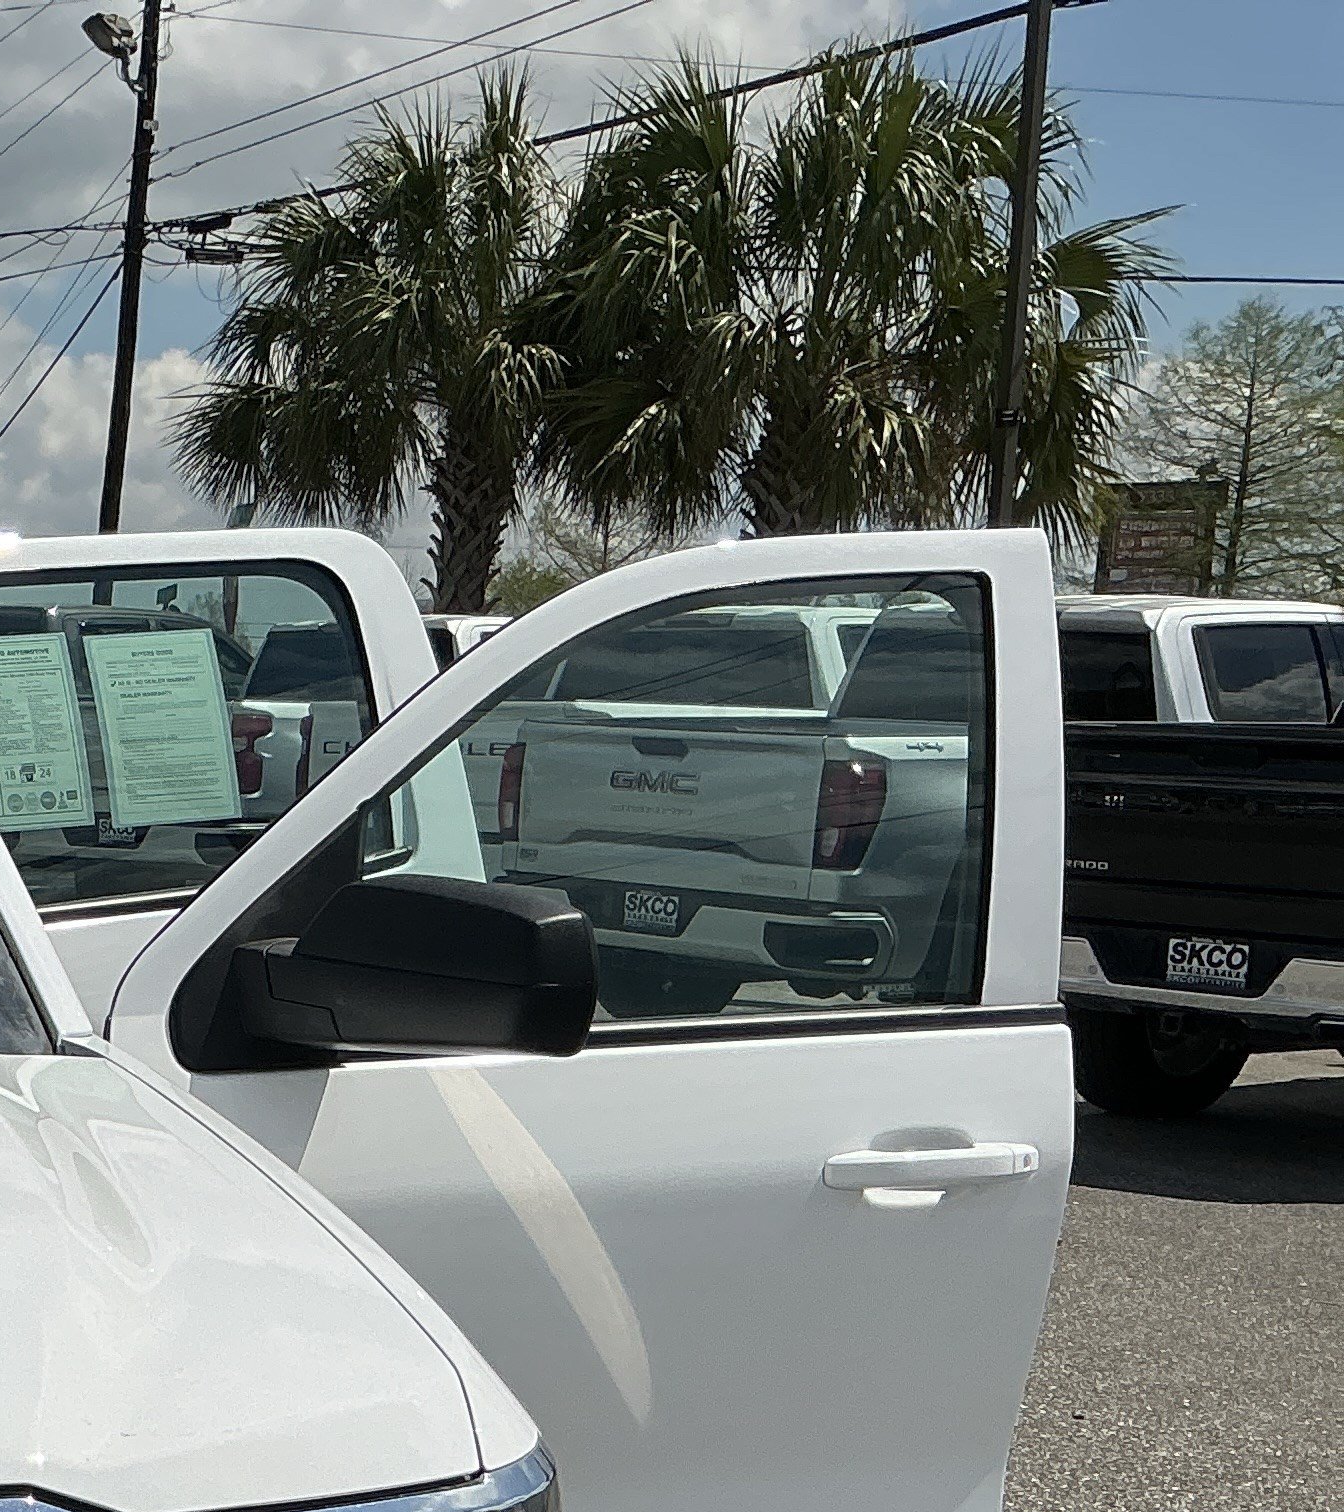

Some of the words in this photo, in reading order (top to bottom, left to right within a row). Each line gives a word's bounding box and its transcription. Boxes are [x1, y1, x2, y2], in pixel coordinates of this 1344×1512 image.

[39, 767, 51, 778] 24
[610, 770, 701, 796] GMC
[625, 893, 677, 917] SKCO
[1169, 941, 1248, 970] SKCO
